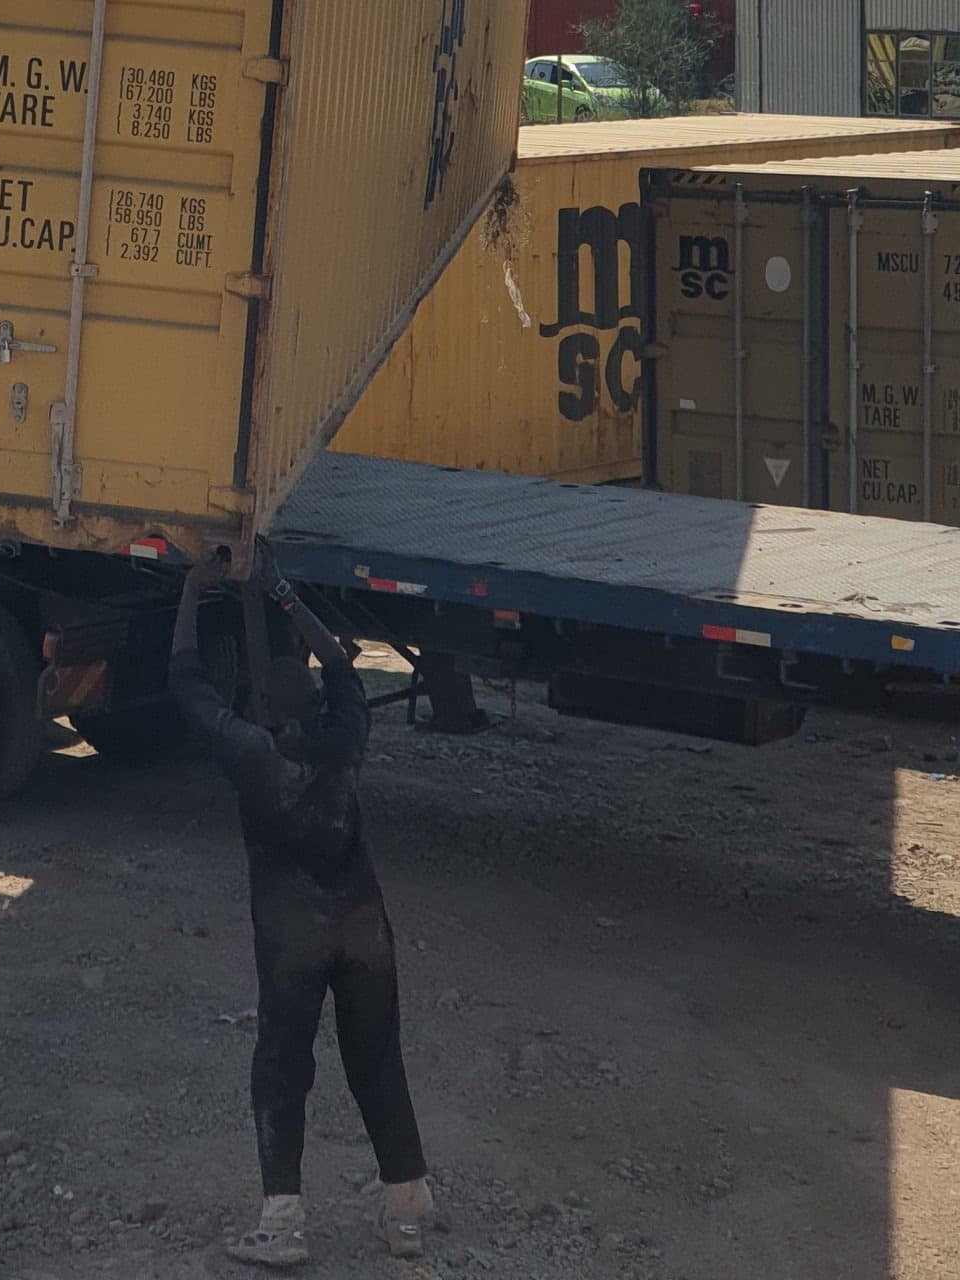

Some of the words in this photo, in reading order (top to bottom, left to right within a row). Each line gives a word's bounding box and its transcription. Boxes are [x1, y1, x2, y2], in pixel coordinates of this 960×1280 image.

[191, 73, 217, 91] KGS
[190, 91, 216, 109] LBS
[188, 109, 214, 126] KGS
[187, 126, 213, 143] LBS
[180, 197, 206, 215] KGS
[178, 214, 205, 232] LBS
[878, 252, 919, 273] MSCU
[864, 406, 901, 428] TARE
[863, 459, 900, 480] NET
